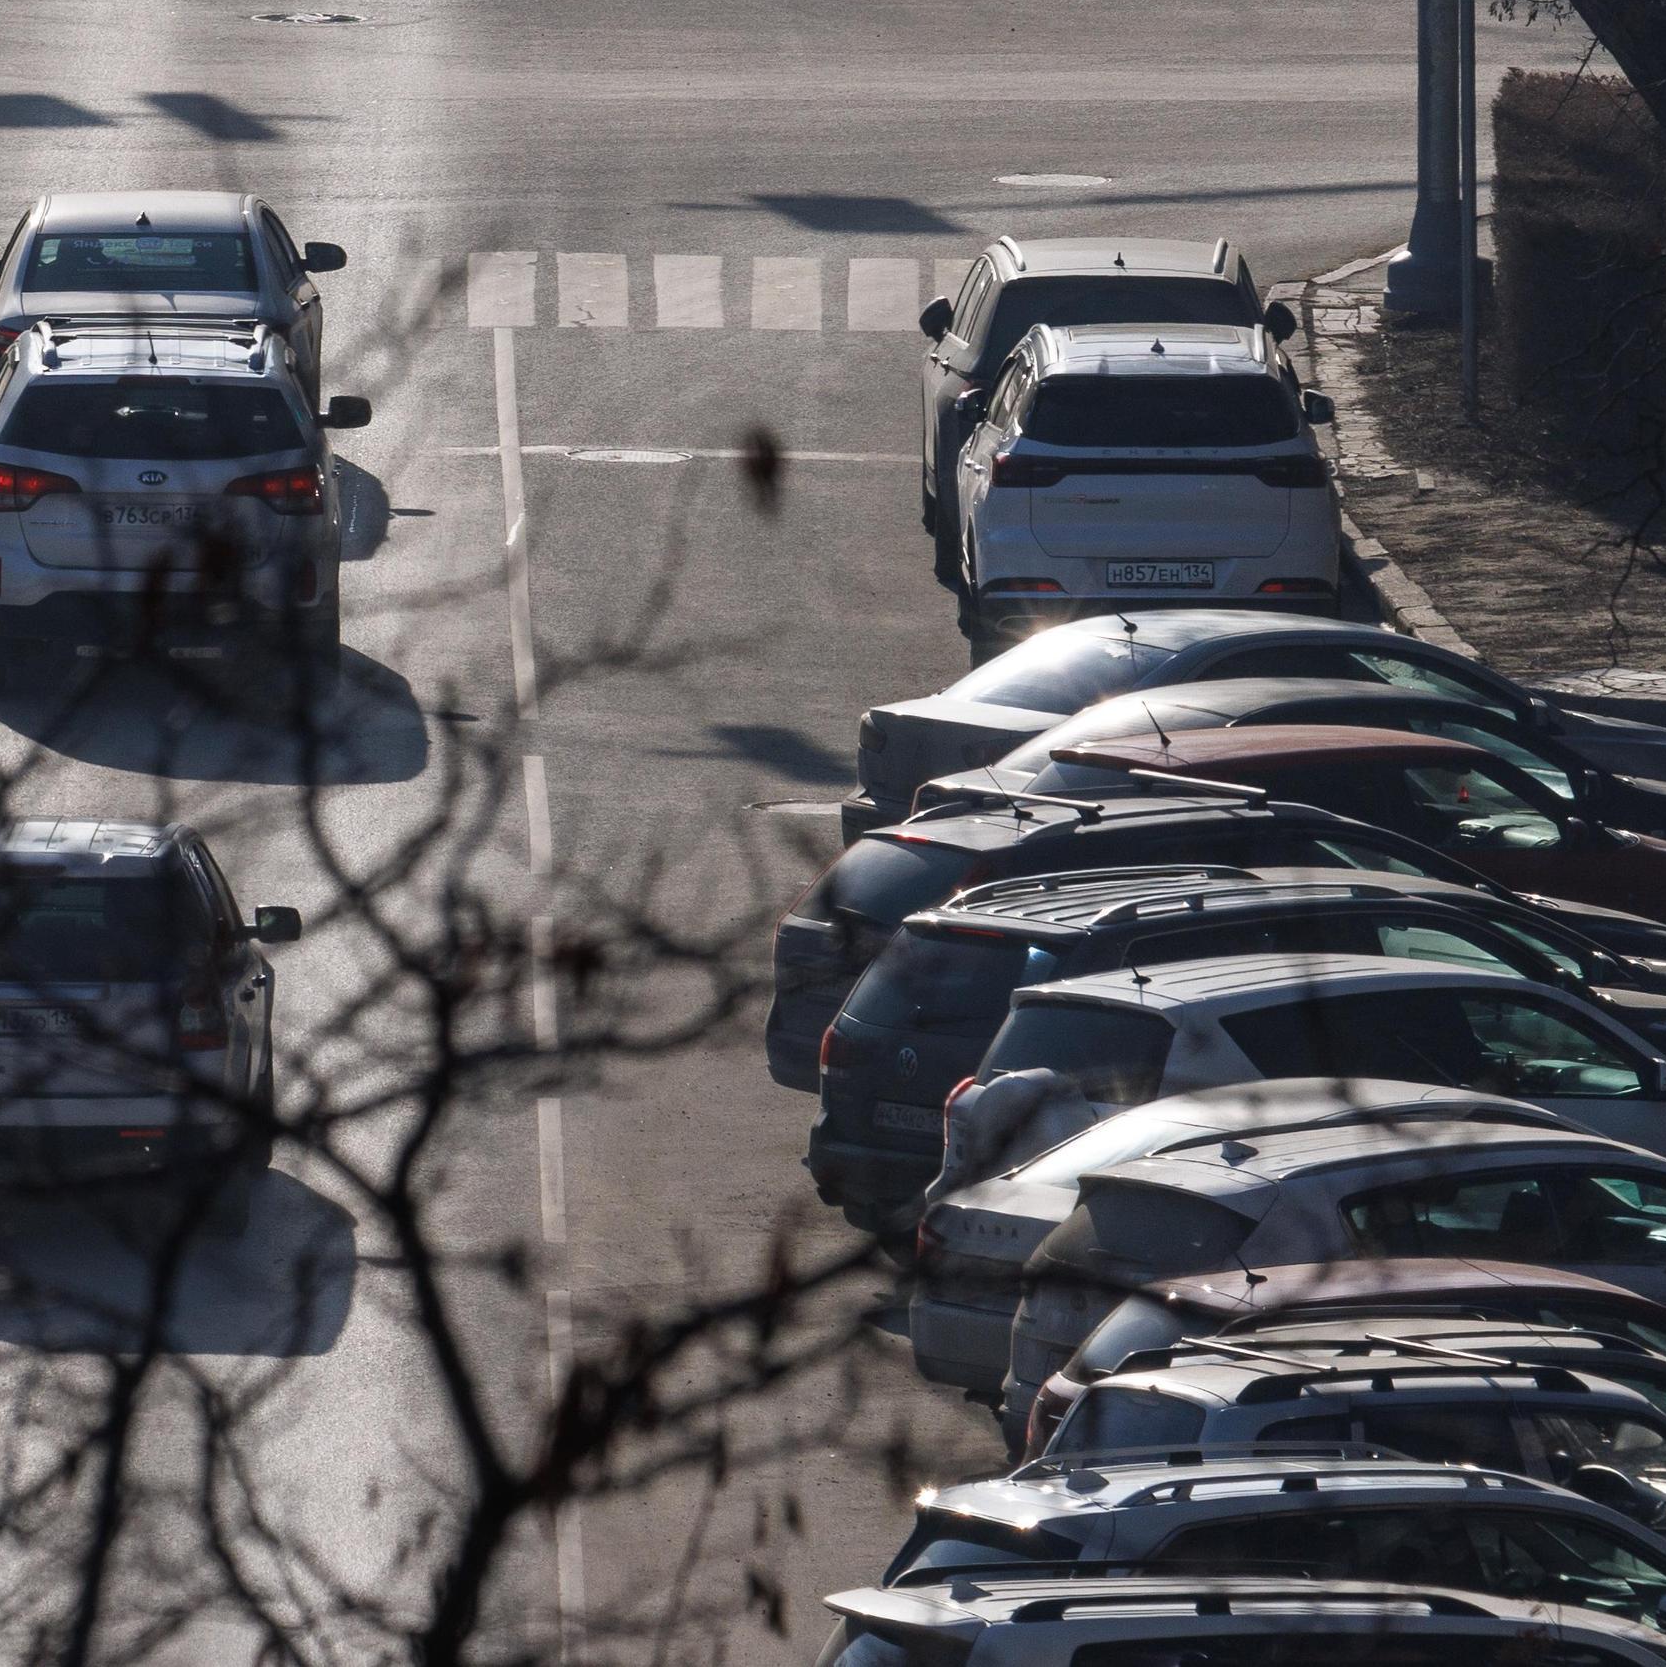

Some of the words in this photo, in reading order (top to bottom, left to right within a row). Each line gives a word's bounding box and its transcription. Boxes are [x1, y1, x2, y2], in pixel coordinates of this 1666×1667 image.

[142, 473, 164, 483] KIA
[103, 506, 172, 526] В763СР
[1112, 563, 1181, 583] Н857ЕН
[1184, 564, 1211, 579] 134
